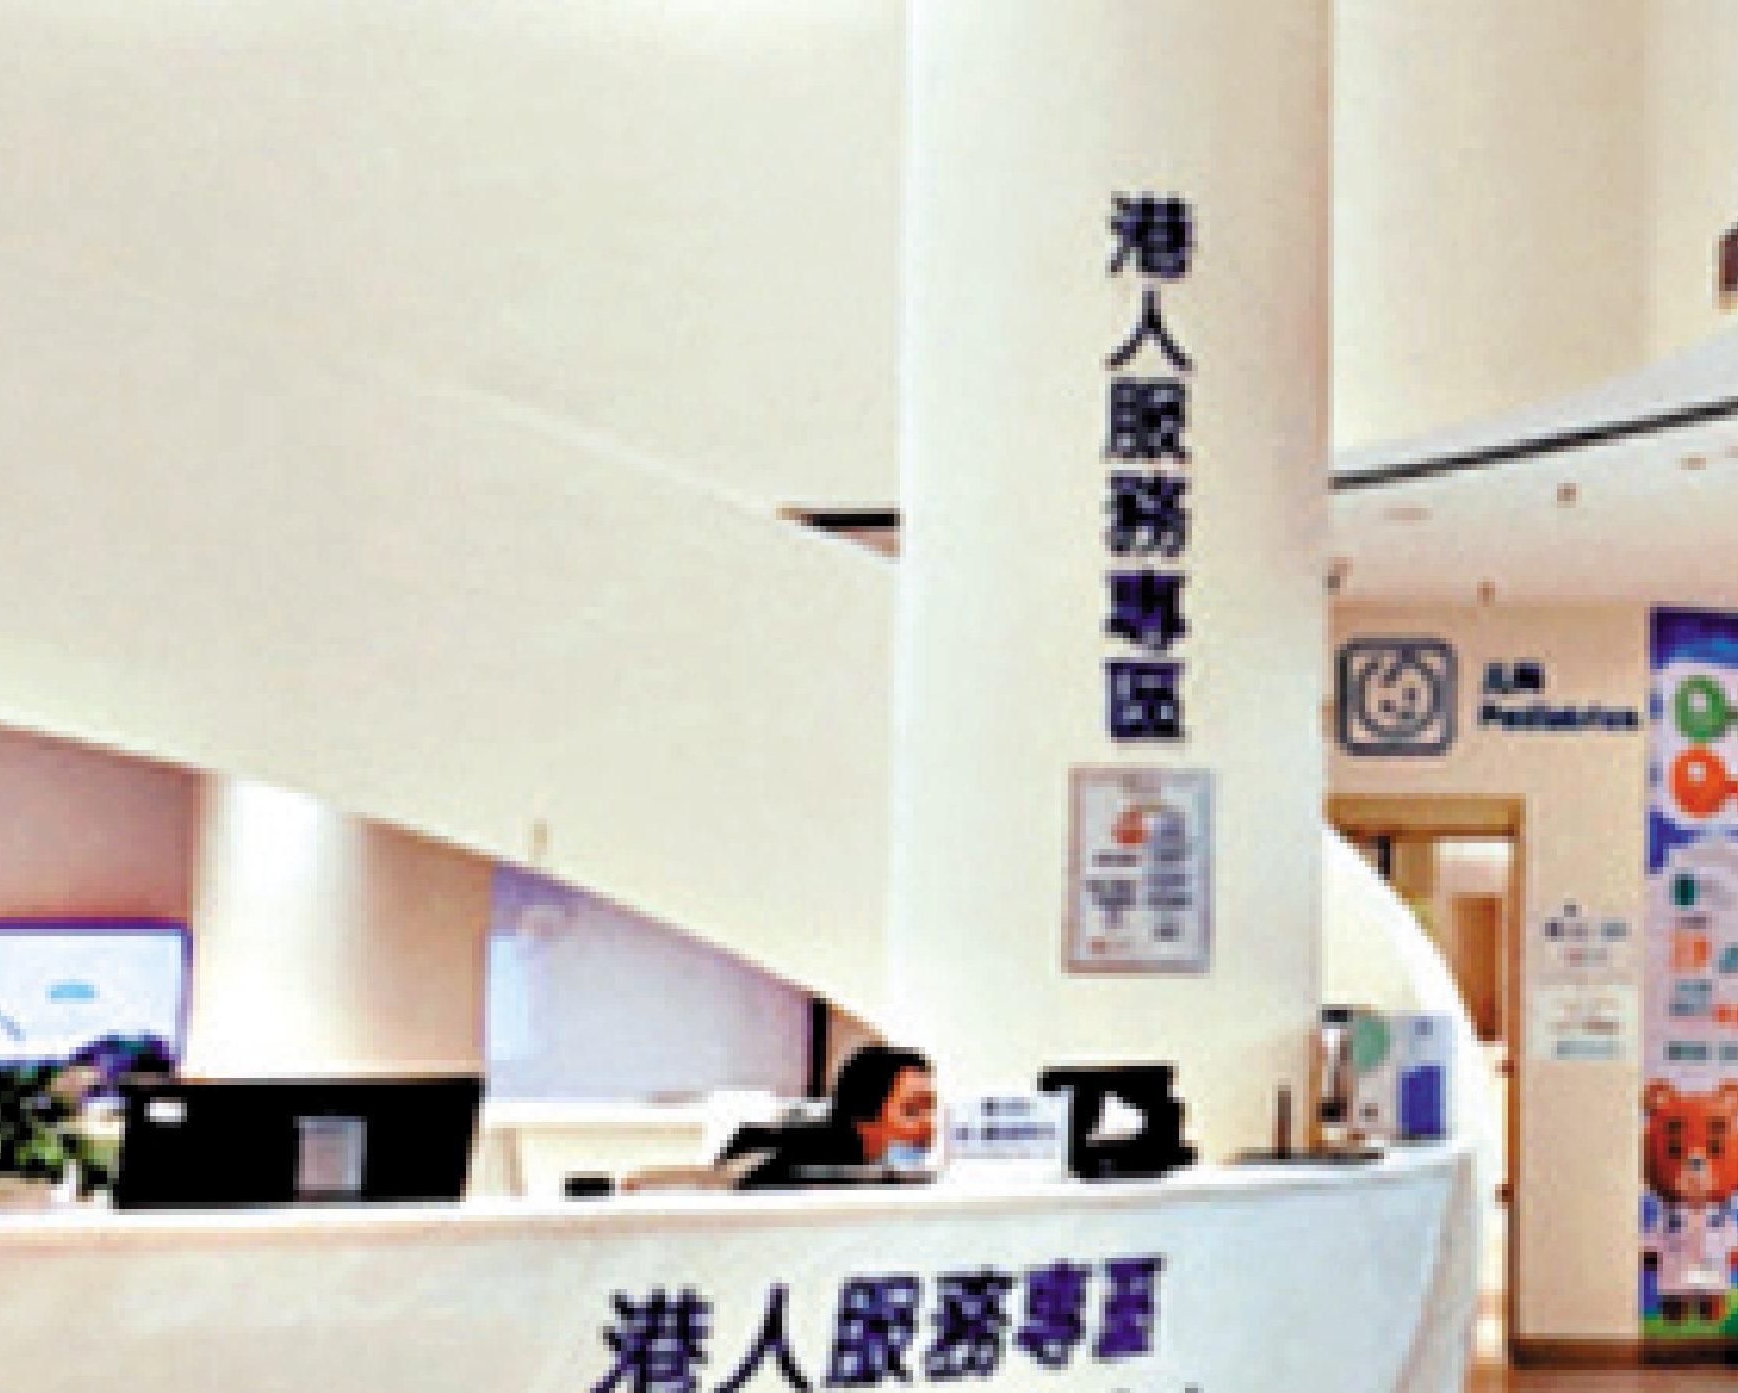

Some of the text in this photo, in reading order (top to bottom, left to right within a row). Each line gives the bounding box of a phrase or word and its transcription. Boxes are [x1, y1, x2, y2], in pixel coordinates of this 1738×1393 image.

[1105, 191, 1192, 743] 港人服務專區
